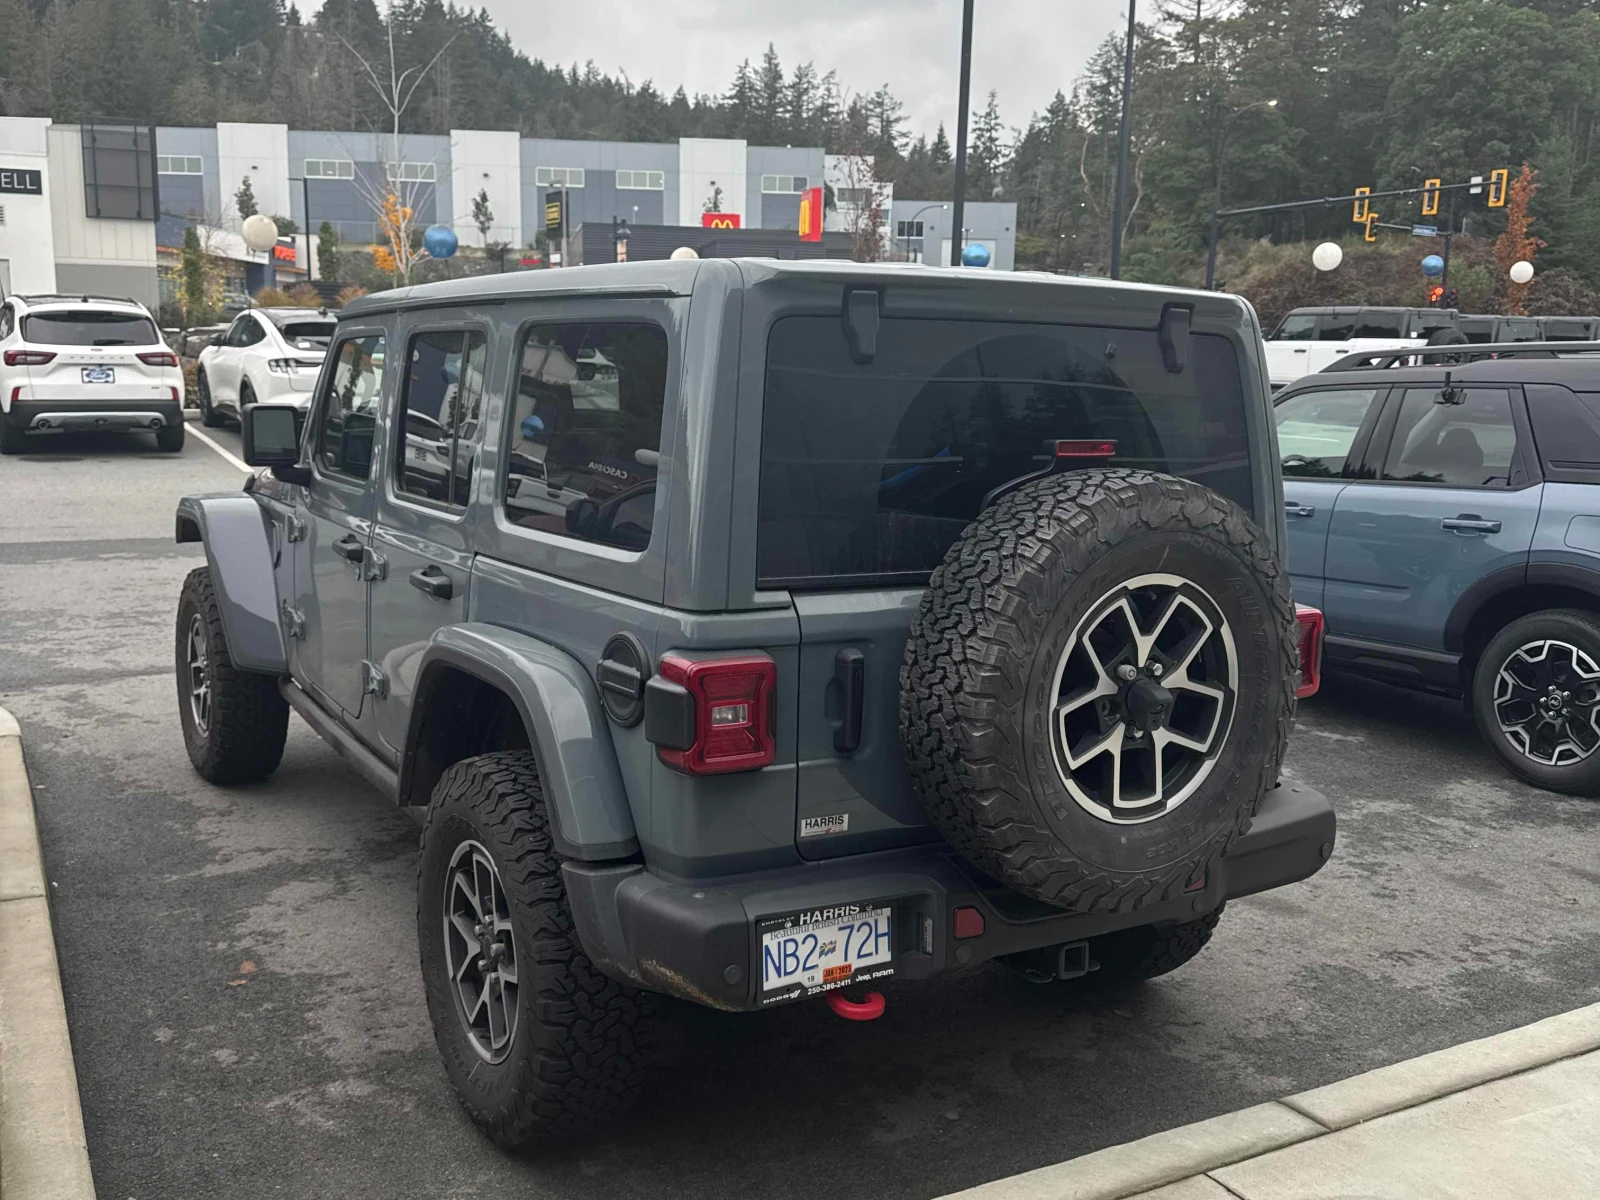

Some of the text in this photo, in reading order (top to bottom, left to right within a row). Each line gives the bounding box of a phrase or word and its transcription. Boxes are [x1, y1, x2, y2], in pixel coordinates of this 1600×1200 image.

[1, 172, 38, 189] ELL
[805, 815, 845, 829] HARRIS
[800, 905, 860, 925] HARRIS
[770, 908, 884, 941] Beautiful British Columbia
[764, 916, 890, 982] NB2 72H
[807, 979, 851, 995] 250-386-2411
